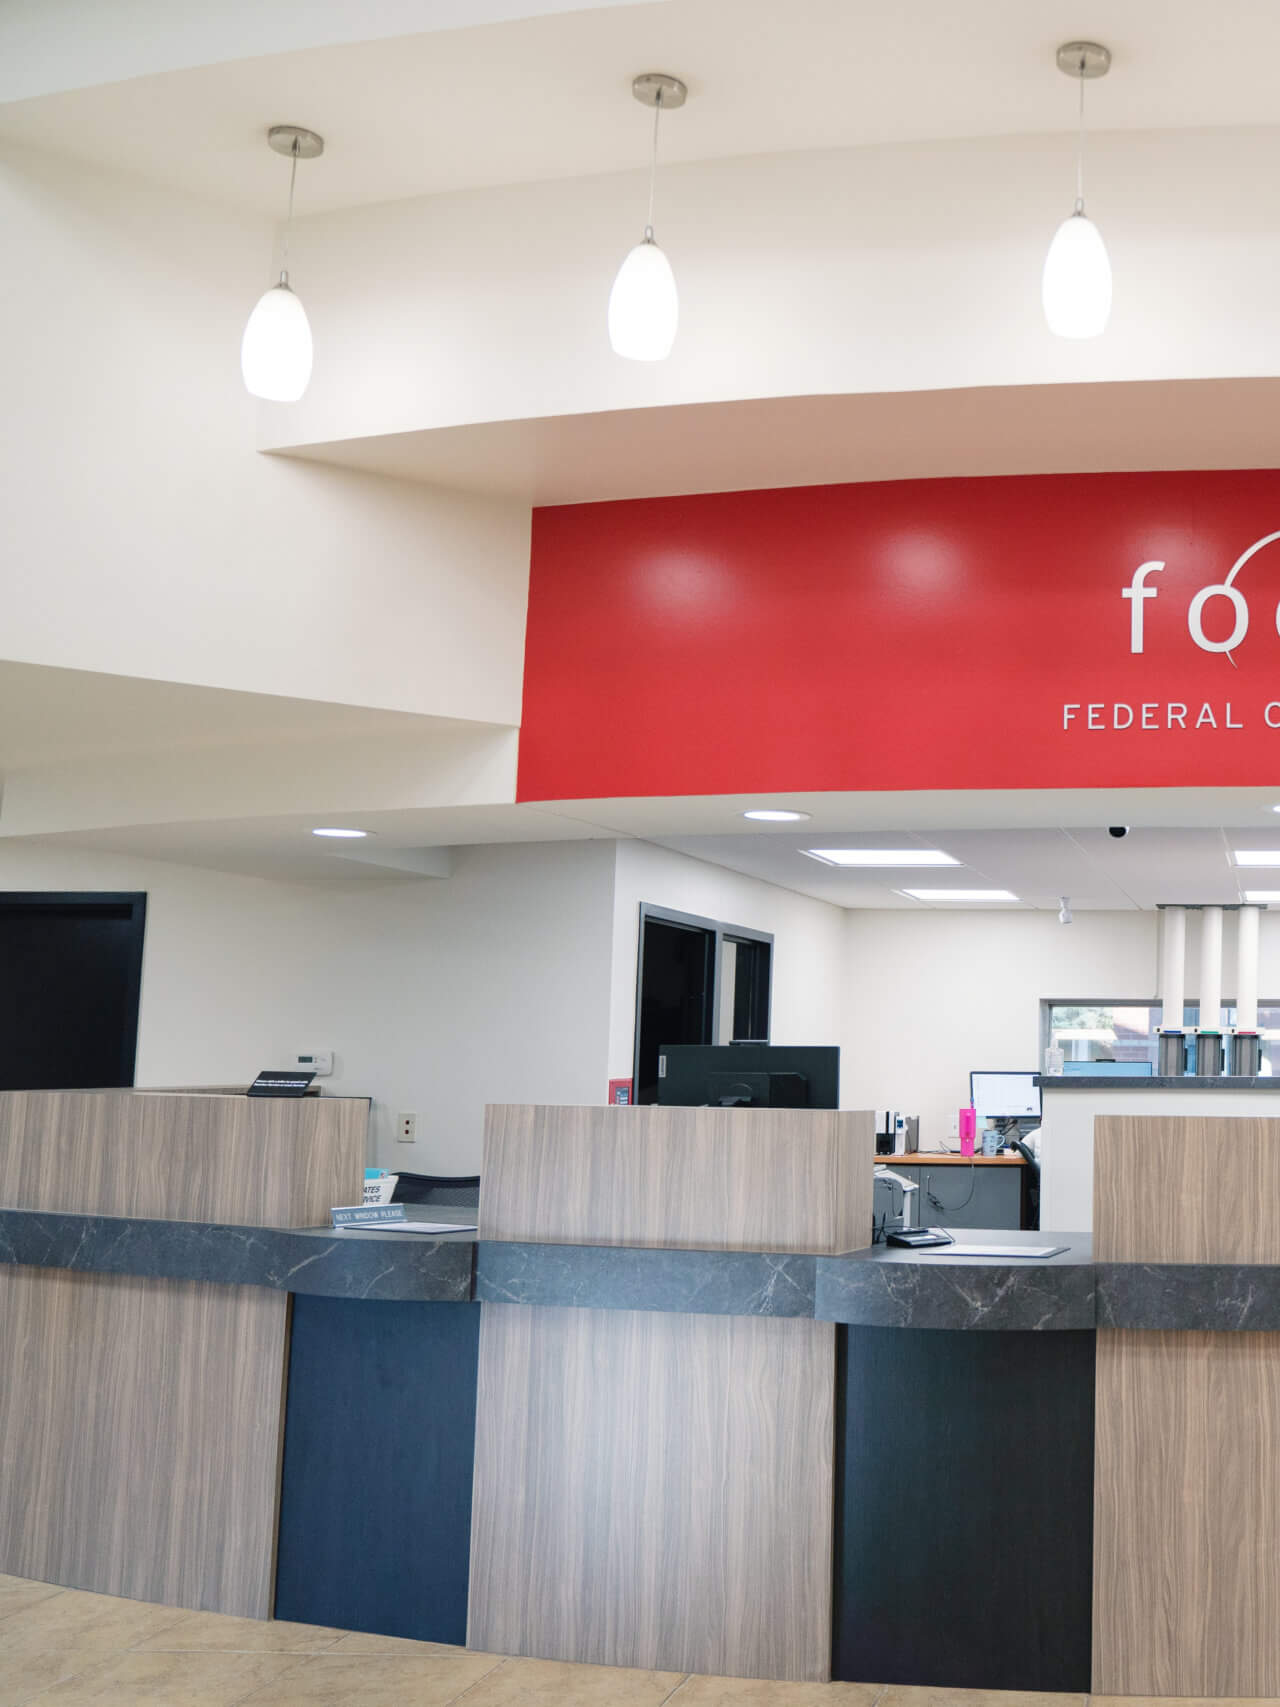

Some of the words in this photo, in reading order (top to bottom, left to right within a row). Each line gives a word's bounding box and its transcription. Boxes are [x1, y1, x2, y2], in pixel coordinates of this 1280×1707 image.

[1063, 702, 1243, 730] FEDERAL
[335, 1213, 352, 1221] NEXT
[355, 1211, 379, 1219] WINDOW
[381, 1209, 403, 1217] PLEASE
